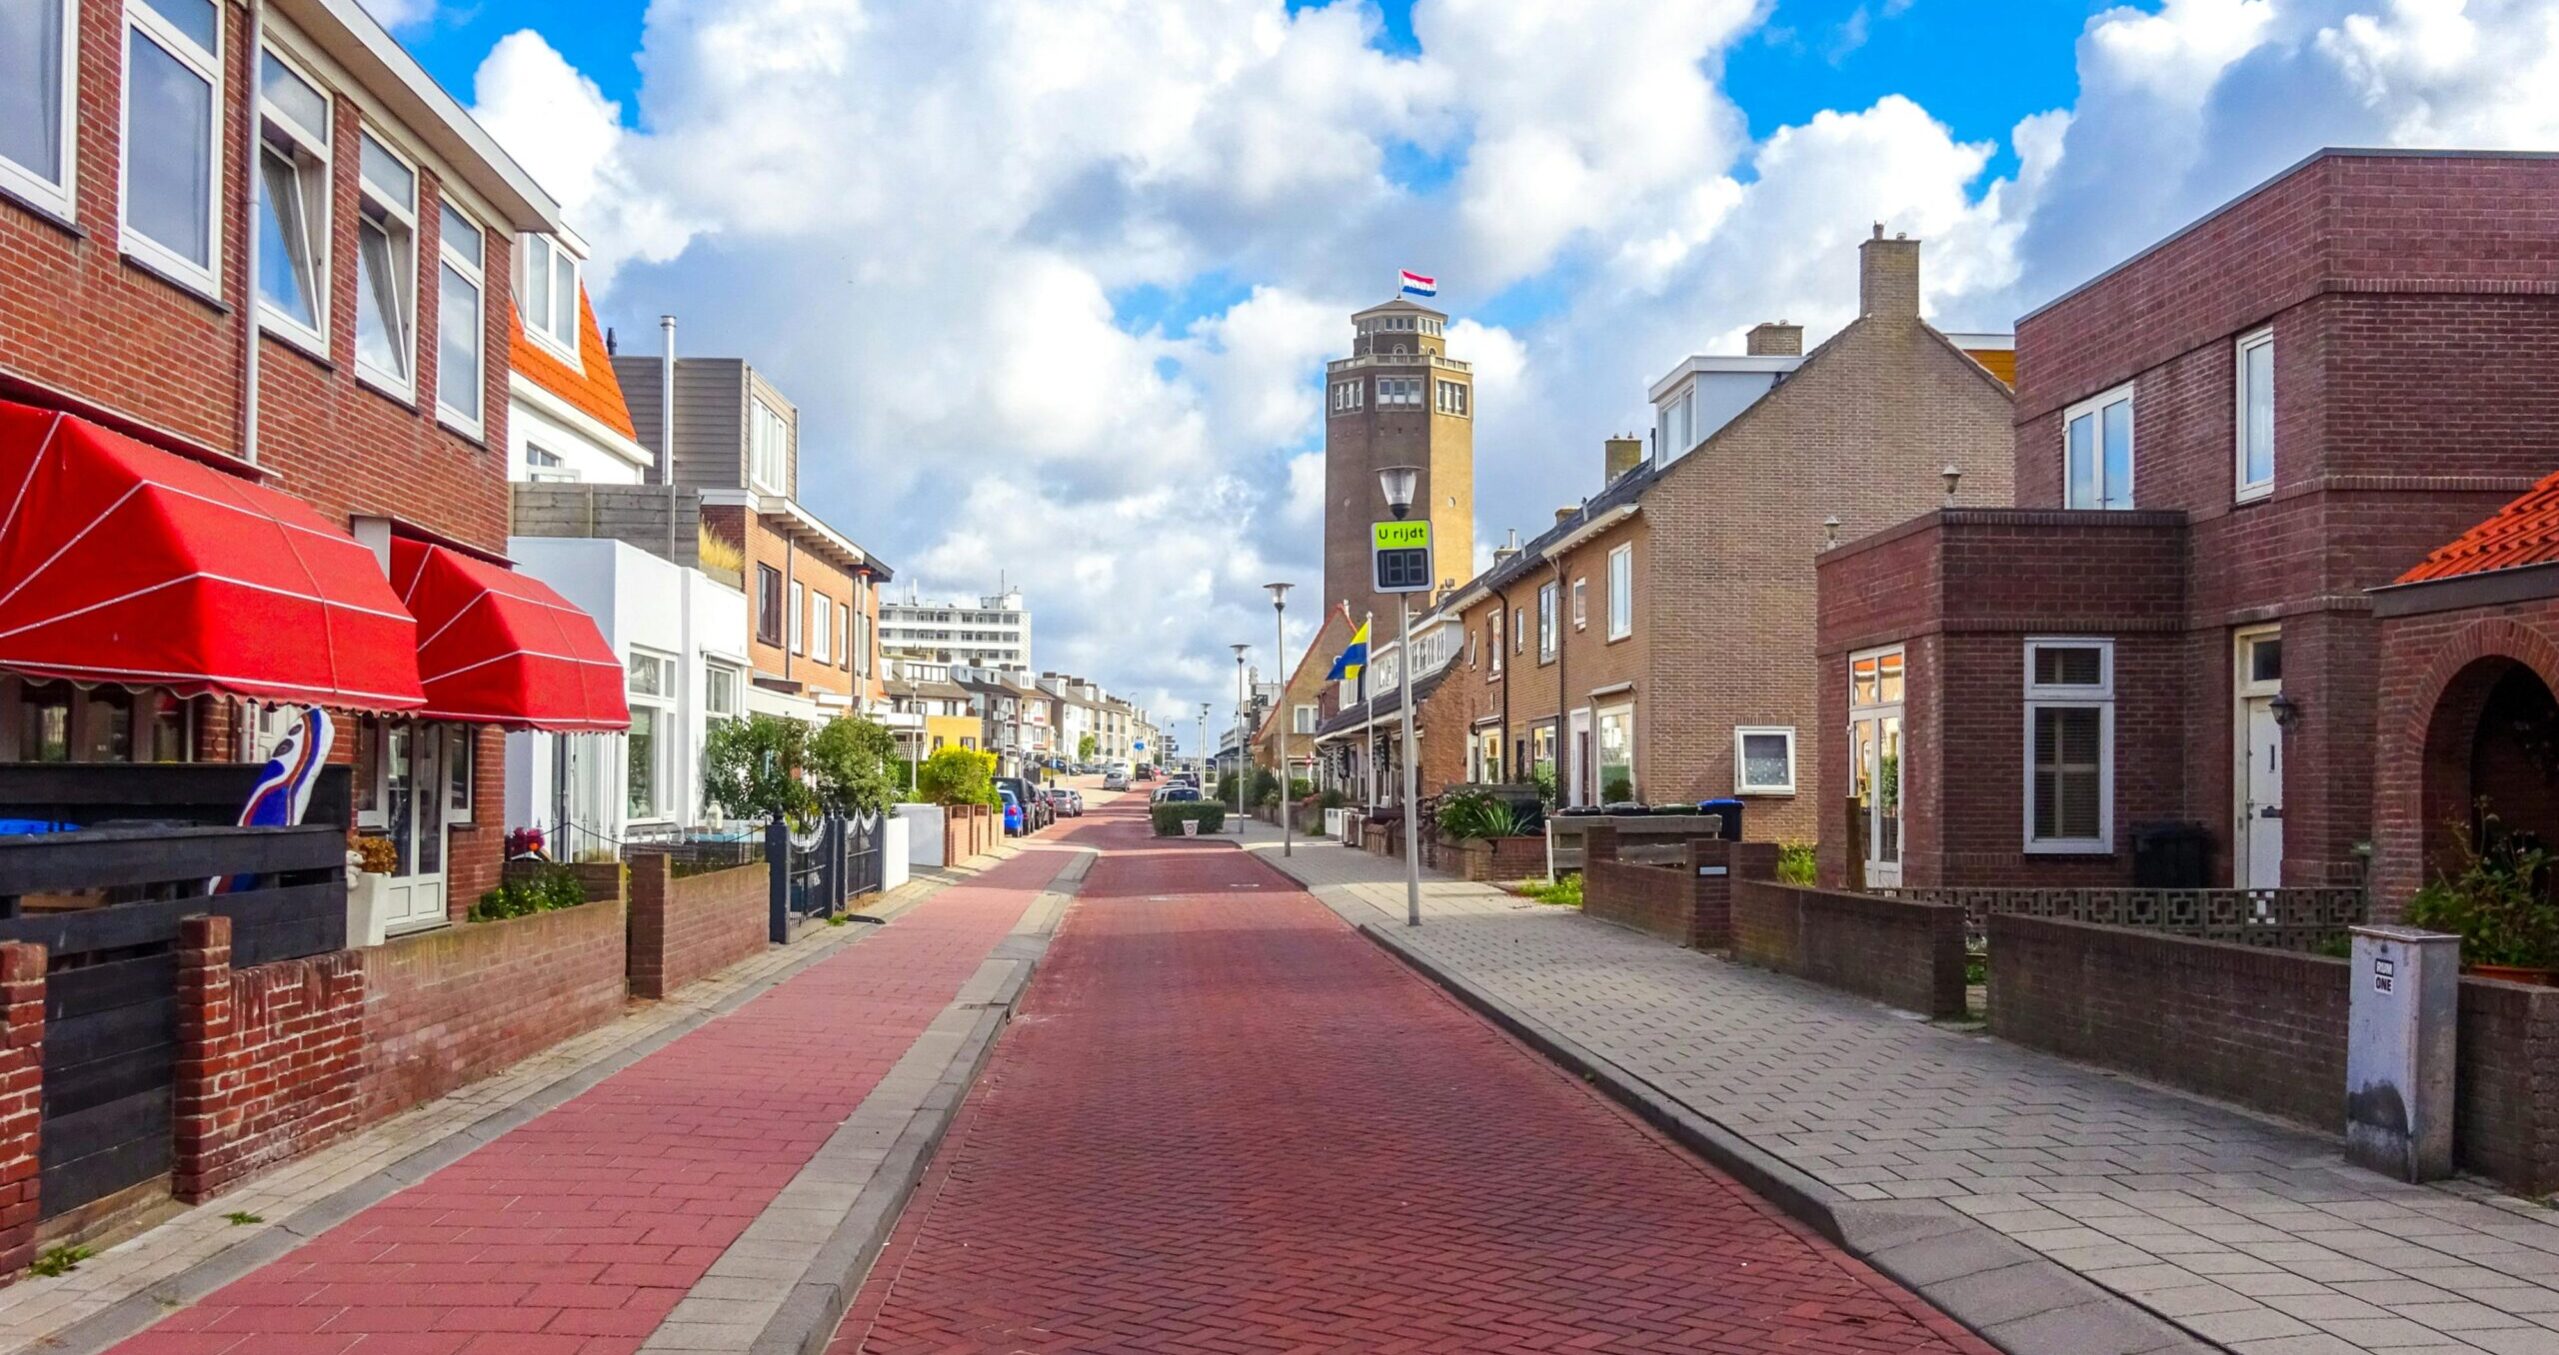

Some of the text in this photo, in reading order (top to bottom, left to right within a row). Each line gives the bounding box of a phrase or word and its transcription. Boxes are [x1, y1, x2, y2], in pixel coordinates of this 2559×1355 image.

[1378, 527, 1424, 543] U rijdt
[2376, 977, 2392, 992] ONE
